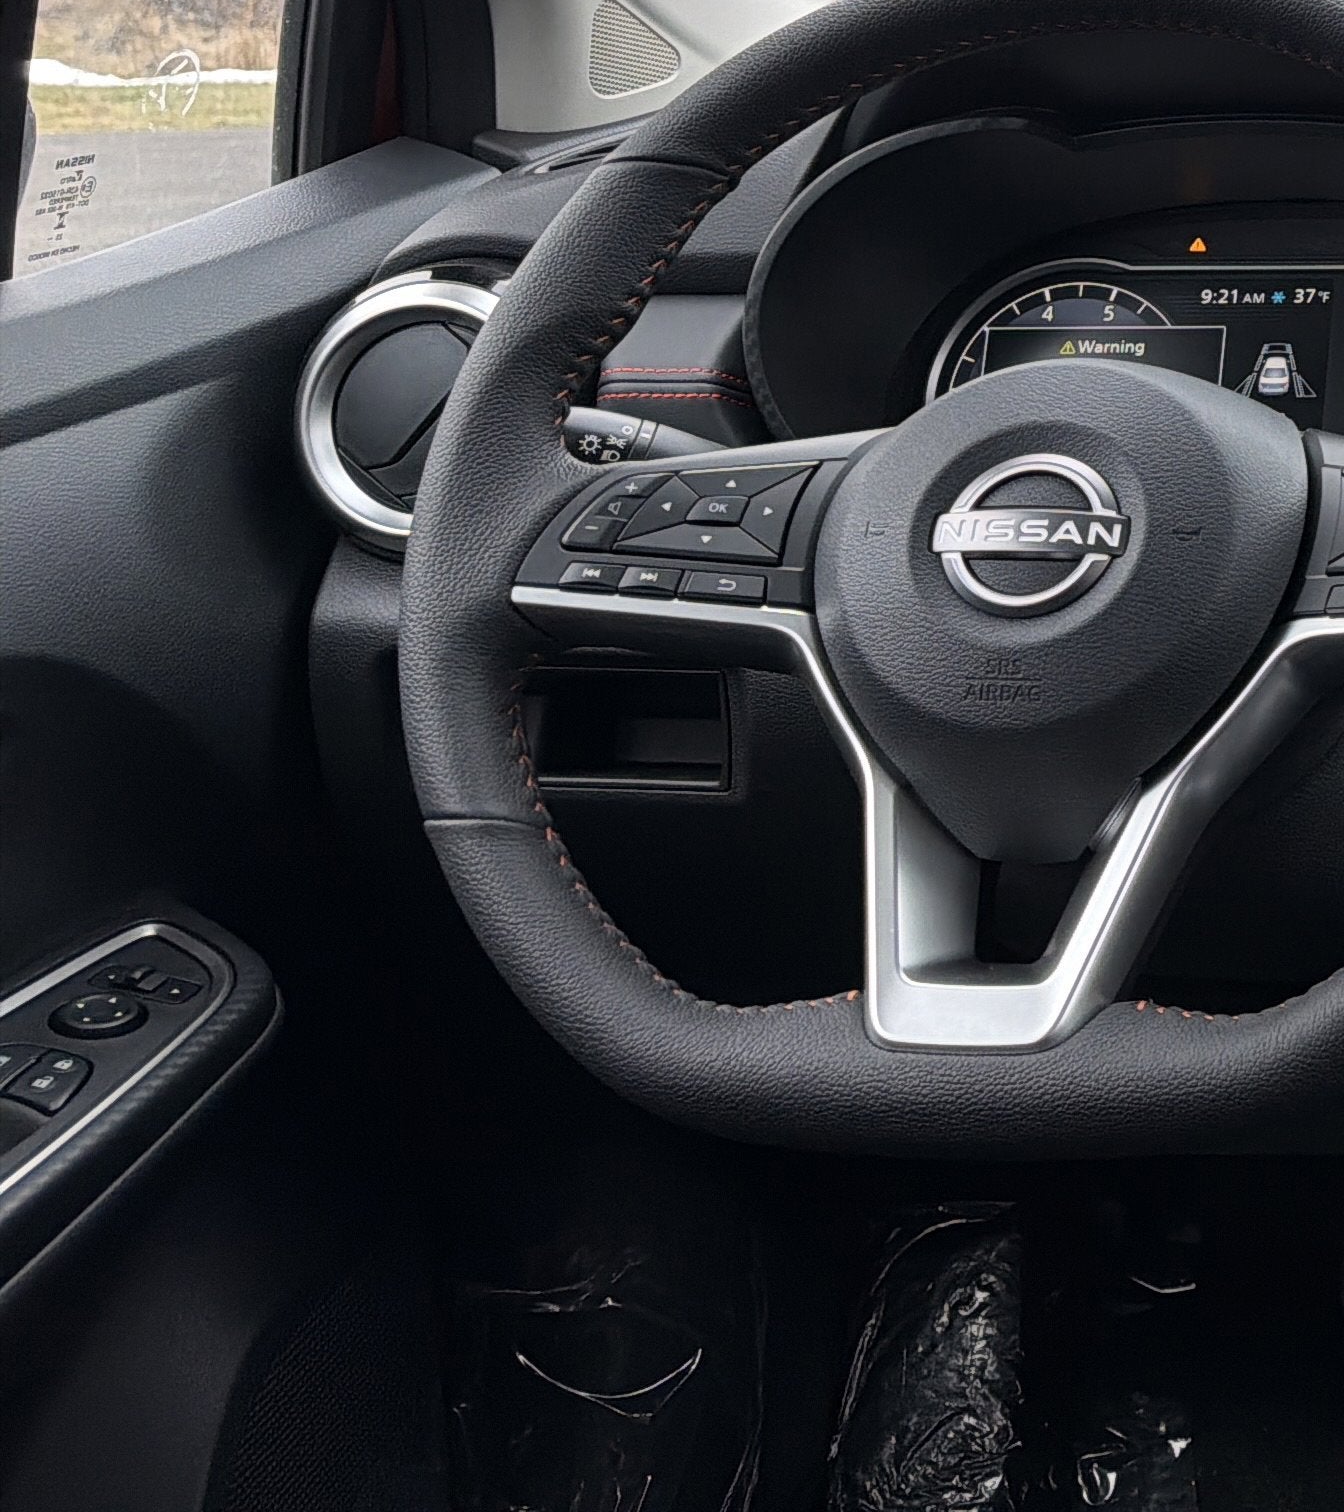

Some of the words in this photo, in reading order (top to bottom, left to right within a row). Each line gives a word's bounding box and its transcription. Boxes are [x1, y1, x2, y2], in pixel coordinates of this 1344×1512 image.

[1200, 289, 1239, 304] 9:21
[1242, 293, 1265, 304] AM
[1041, 305, 1054, 322] 4
[1103, 305, 1116, 322] 5
[1078, 339, 1145, 356] Warning
[708, 502, 727, 514] OK
[938, 518, 1122, 547] NISSAN
[986, 659, 1024, 677] SRS
[964, 685, 1042, 704] AIRBAG
